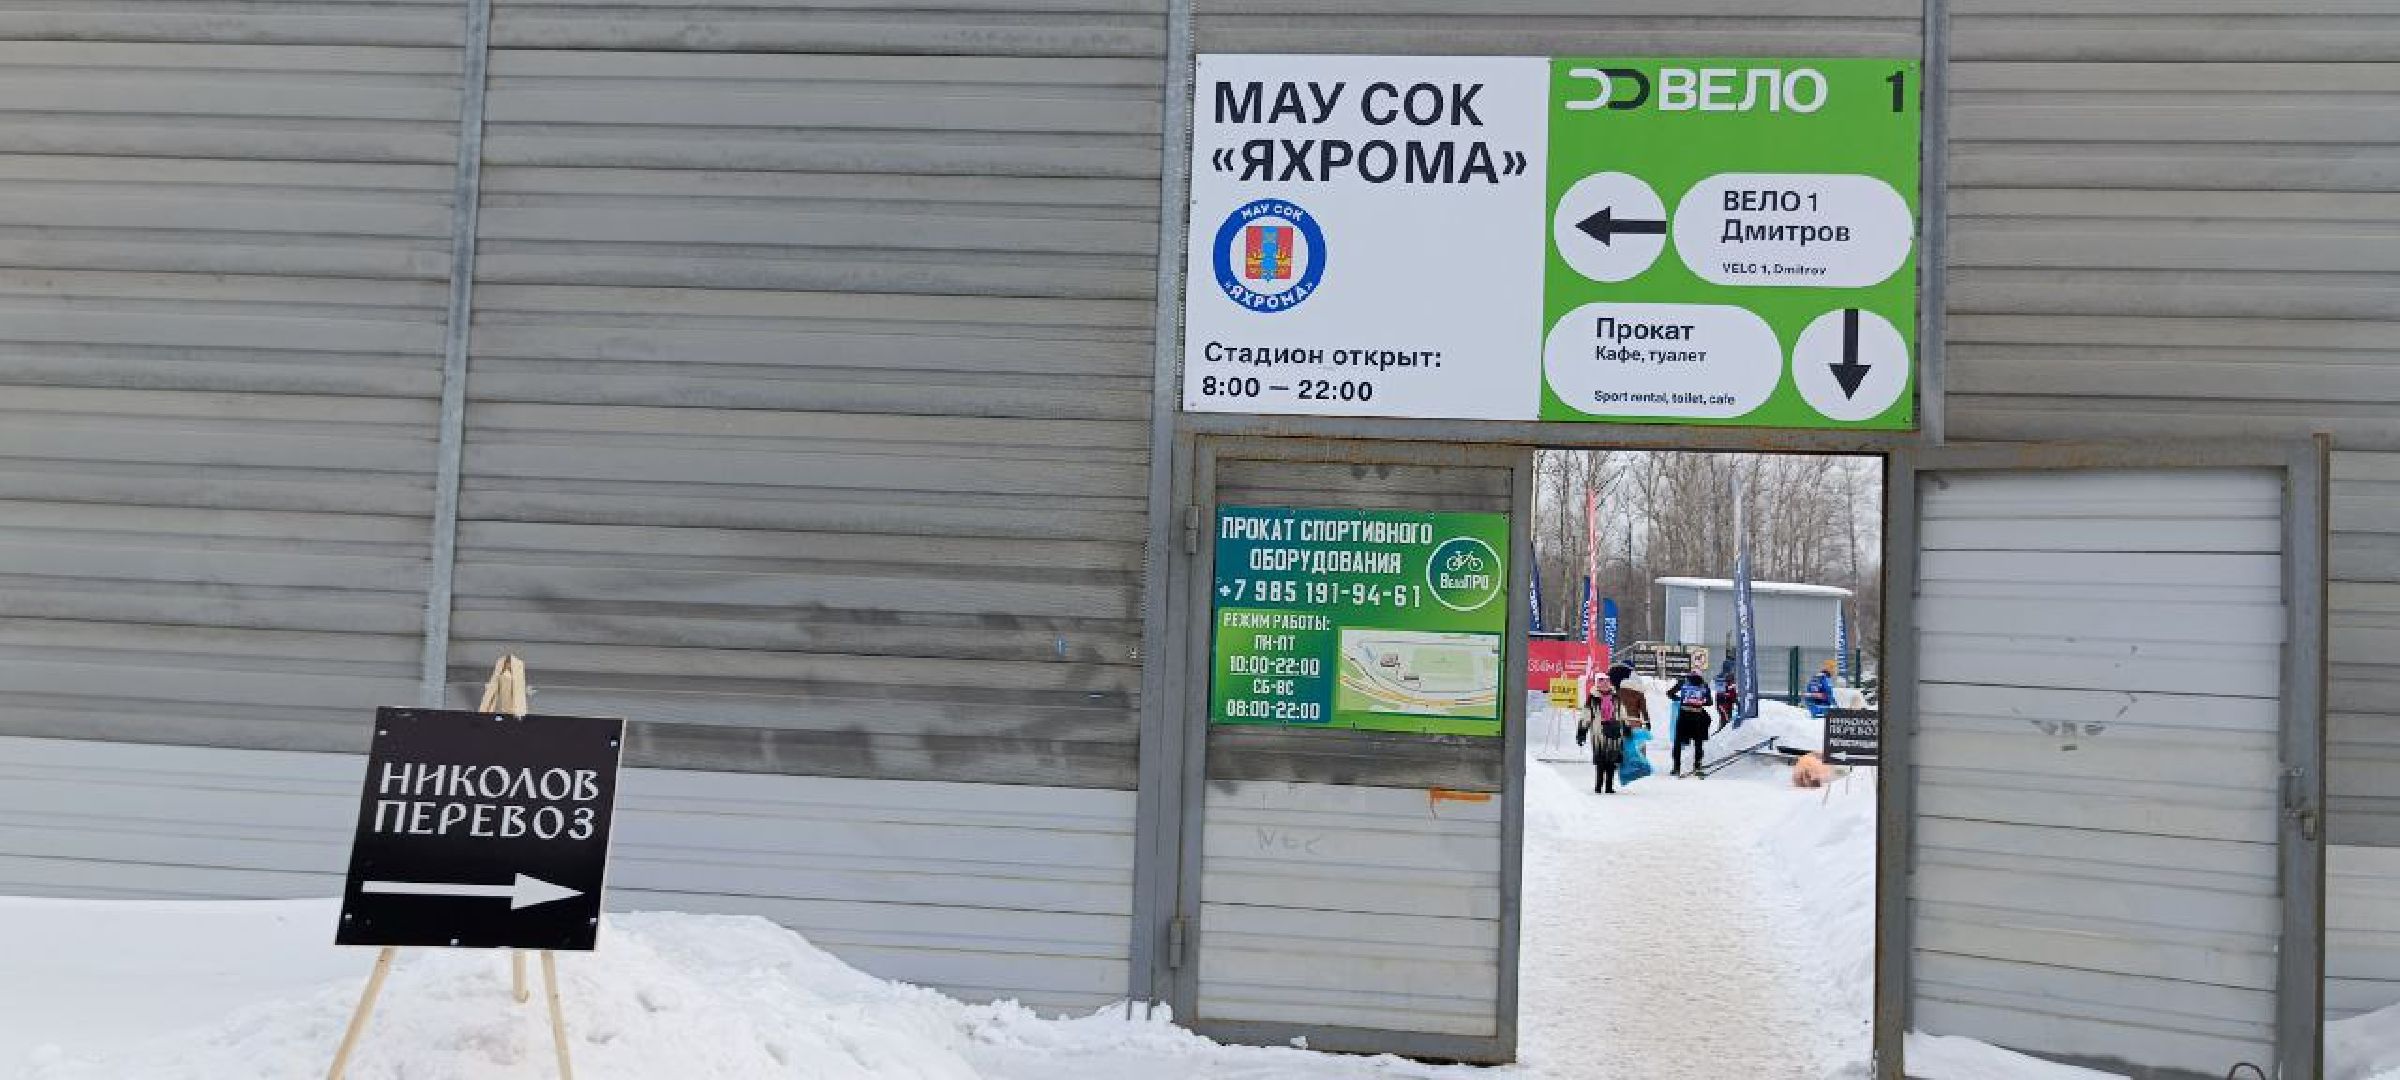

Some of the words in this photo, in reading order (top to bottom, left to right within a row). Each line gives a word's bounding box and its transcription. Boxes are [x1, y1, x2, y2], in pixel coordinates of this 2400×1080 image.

[1214, 81, 1347, 124] МАУ
[1361, 81, 1484, 126] СОК
[1658, 68, 1829, 113] ВЕЛО
[1886, 70, 1904, 113] 1
[1212, 139, 1528, 184] «ЯХРОМА»
[1240, 203, 1270, 220] МАУ
[1274, 204, 1304, 221] СОК
[1723, 190, 1801, 212] ВЕЛО
[1807, 192, 1817, 212] 1
[1720, 218, 1850, 247] Дмитров
[1722, 263, 1757, 274] VELO
[1223, 281, 1314, 309] «ЯХРОМА»
[1596, 317, 1696, 345] Прокат
[1204, 341, 1324, 367] Стадион
[1332, 348, 1442, 372] открыт:
[1595, 345, 1645, 364] Кафе,
[1648, 350, 1707, 365] туалет
[1202, 376, 1261, 398] 8:00
[1298, 379, 1374, 402] 22:00
[1594, 390, 1628, 404] Sport
[1672, 393, 1707, 405] toilet,
[1710, 393, 1737, 406] cafe
[1221, 517, 1295, 541] ПРОКАТ
[1300, 520, 1433, 545] СПОРТИВНОГО
[1250, 548, 1401, 575] ОБОРУДОВАНИЯ
[1219, 578, 1247, 601] +7
[1255, 580, 1297, 602] 985
[1305, 582, 1421, 608] 191-94-61
[1223, 612, 1270, 629] РЕЖИМ
[1273, 614, 1331, 631] РАБОТЫ:
[1255, 634, 1296, 651] ПН-ПТ
[1230, 655, 1320, 676] 10:00-22:00
[1253, 678, 1294, 695] СБ-ВС
[1227, 699, 1321, 720] 08:00-22:00
[379, 762, 600, 801] НИКОЛОВ
[374, 799, 595, 840] ПЕРЕВОЗ
